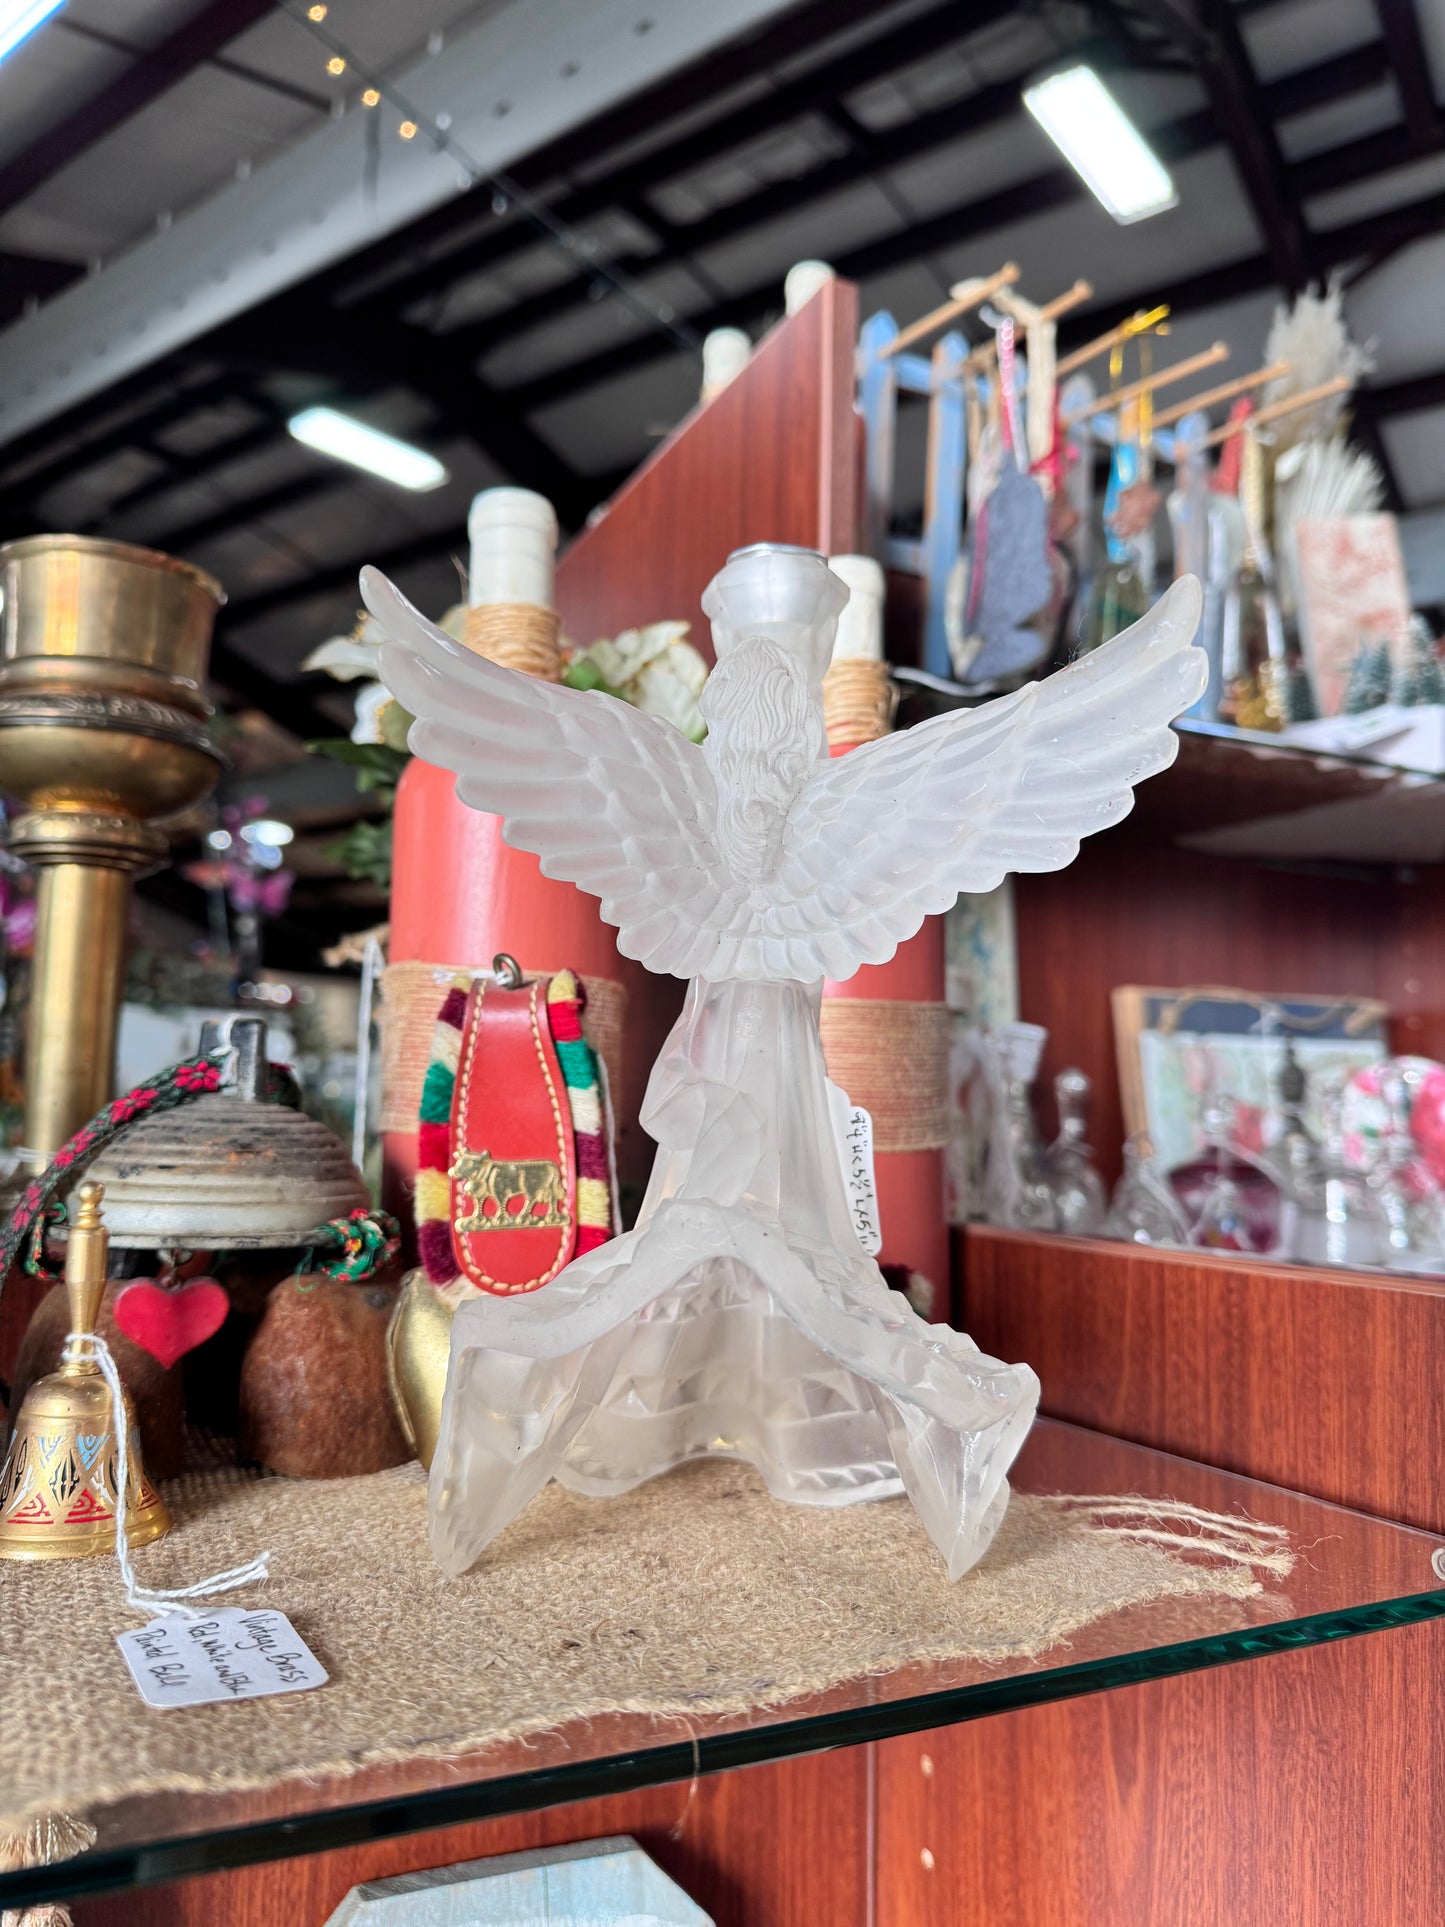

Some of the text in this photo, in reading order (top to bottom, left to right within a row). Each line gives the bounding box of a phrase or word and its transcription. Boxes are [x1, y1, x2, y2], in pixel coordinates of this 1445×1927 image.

[131, 1628, 192, 1688] Painted Bell
[200, 1639, 234, 1663] White
[235, 1613, 309, 1683] Vintage Brass
